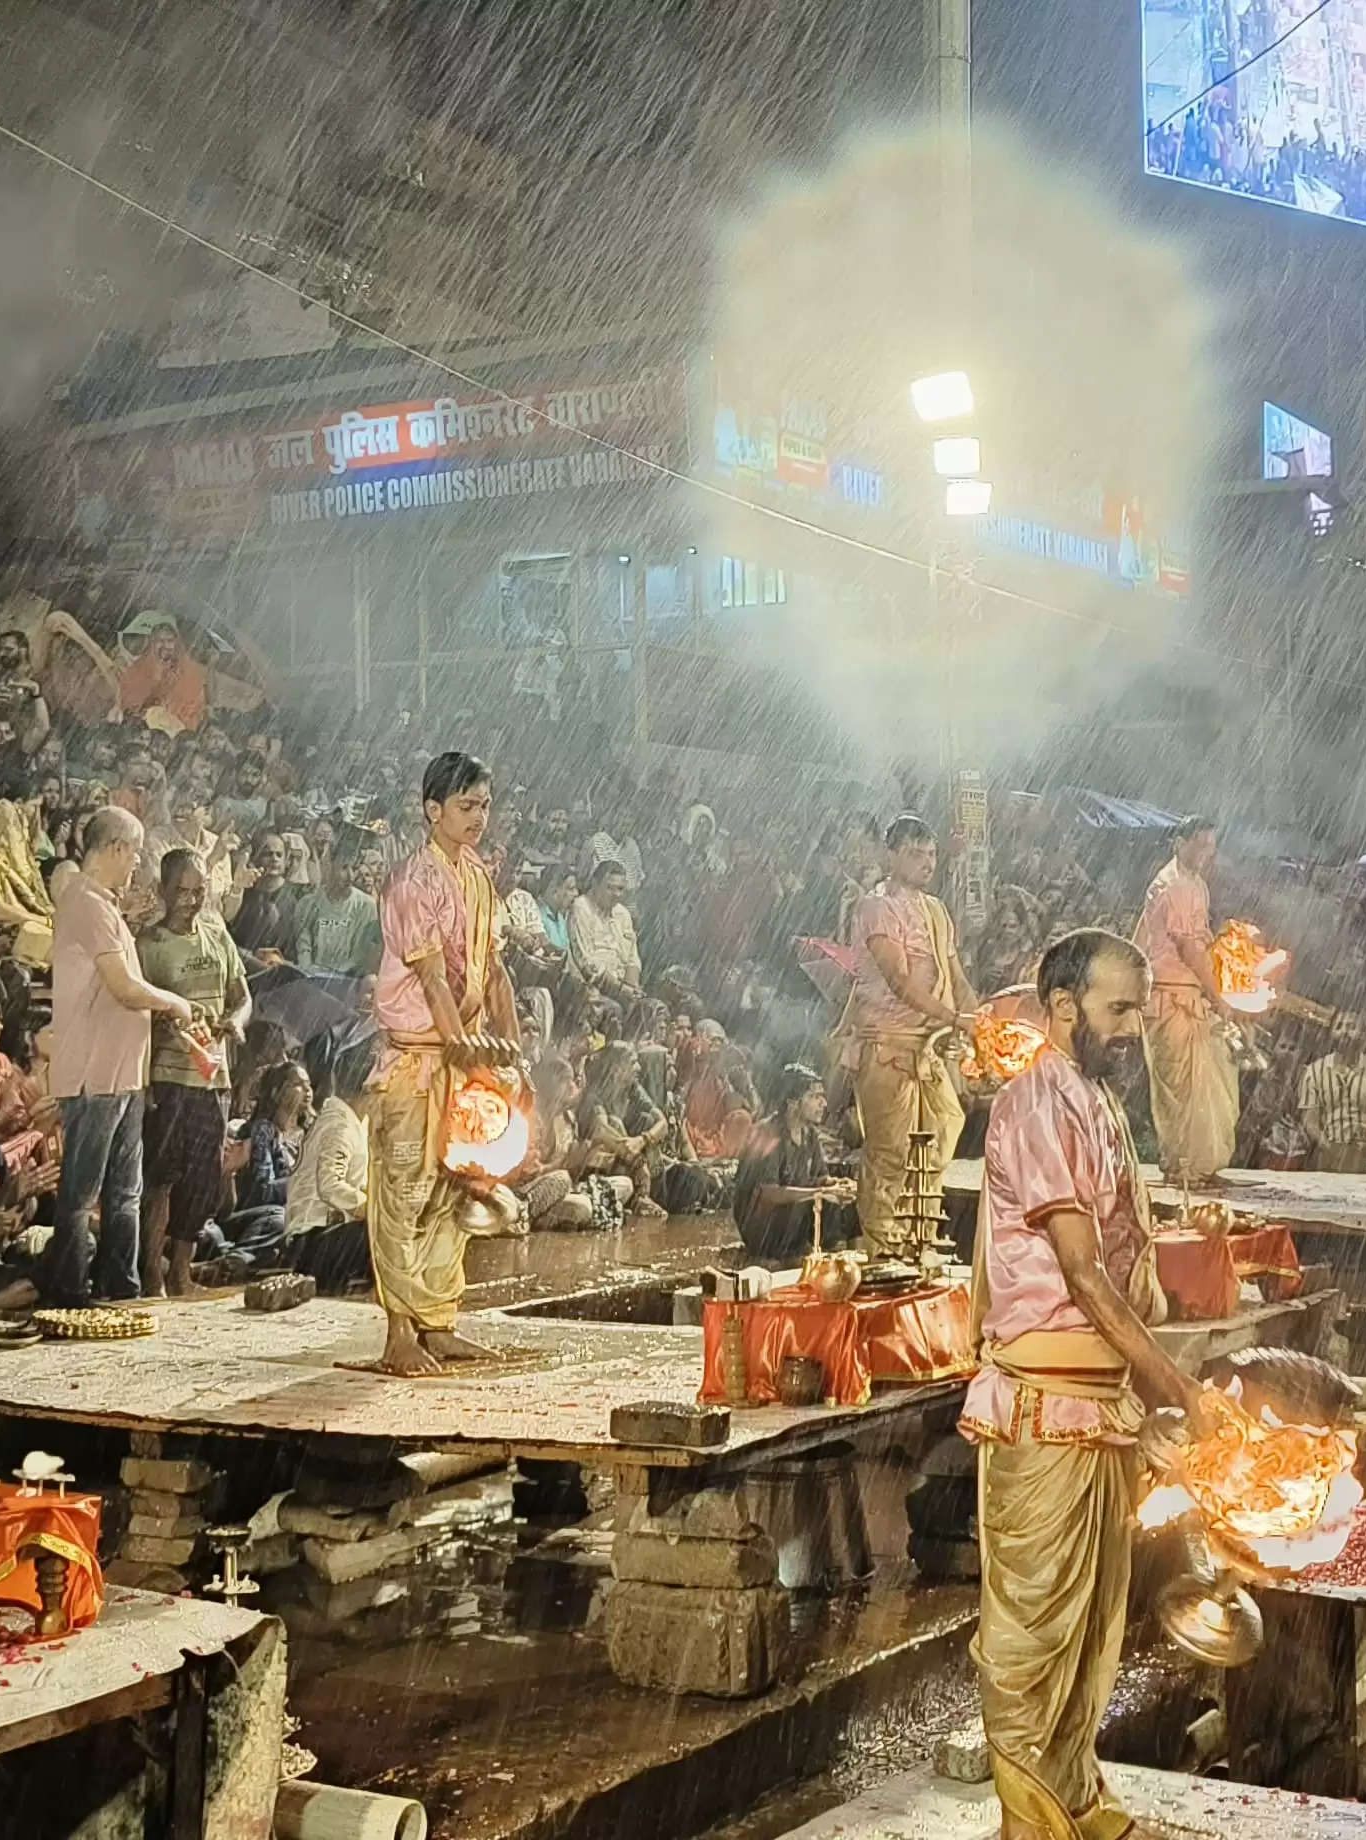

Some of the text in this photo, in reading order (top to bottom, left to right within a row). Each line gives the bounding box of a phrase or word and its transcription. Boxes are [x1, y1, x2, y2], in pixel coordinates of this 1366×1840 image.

[263, 430, 314, 468] जल
[322, 409, 399, 475] पुलिस
[270, 490, 321, 526] RIVER
[324, 480, 385, 517] POLICE
[387, 456, 566, 510] COMMISSIONERATE
